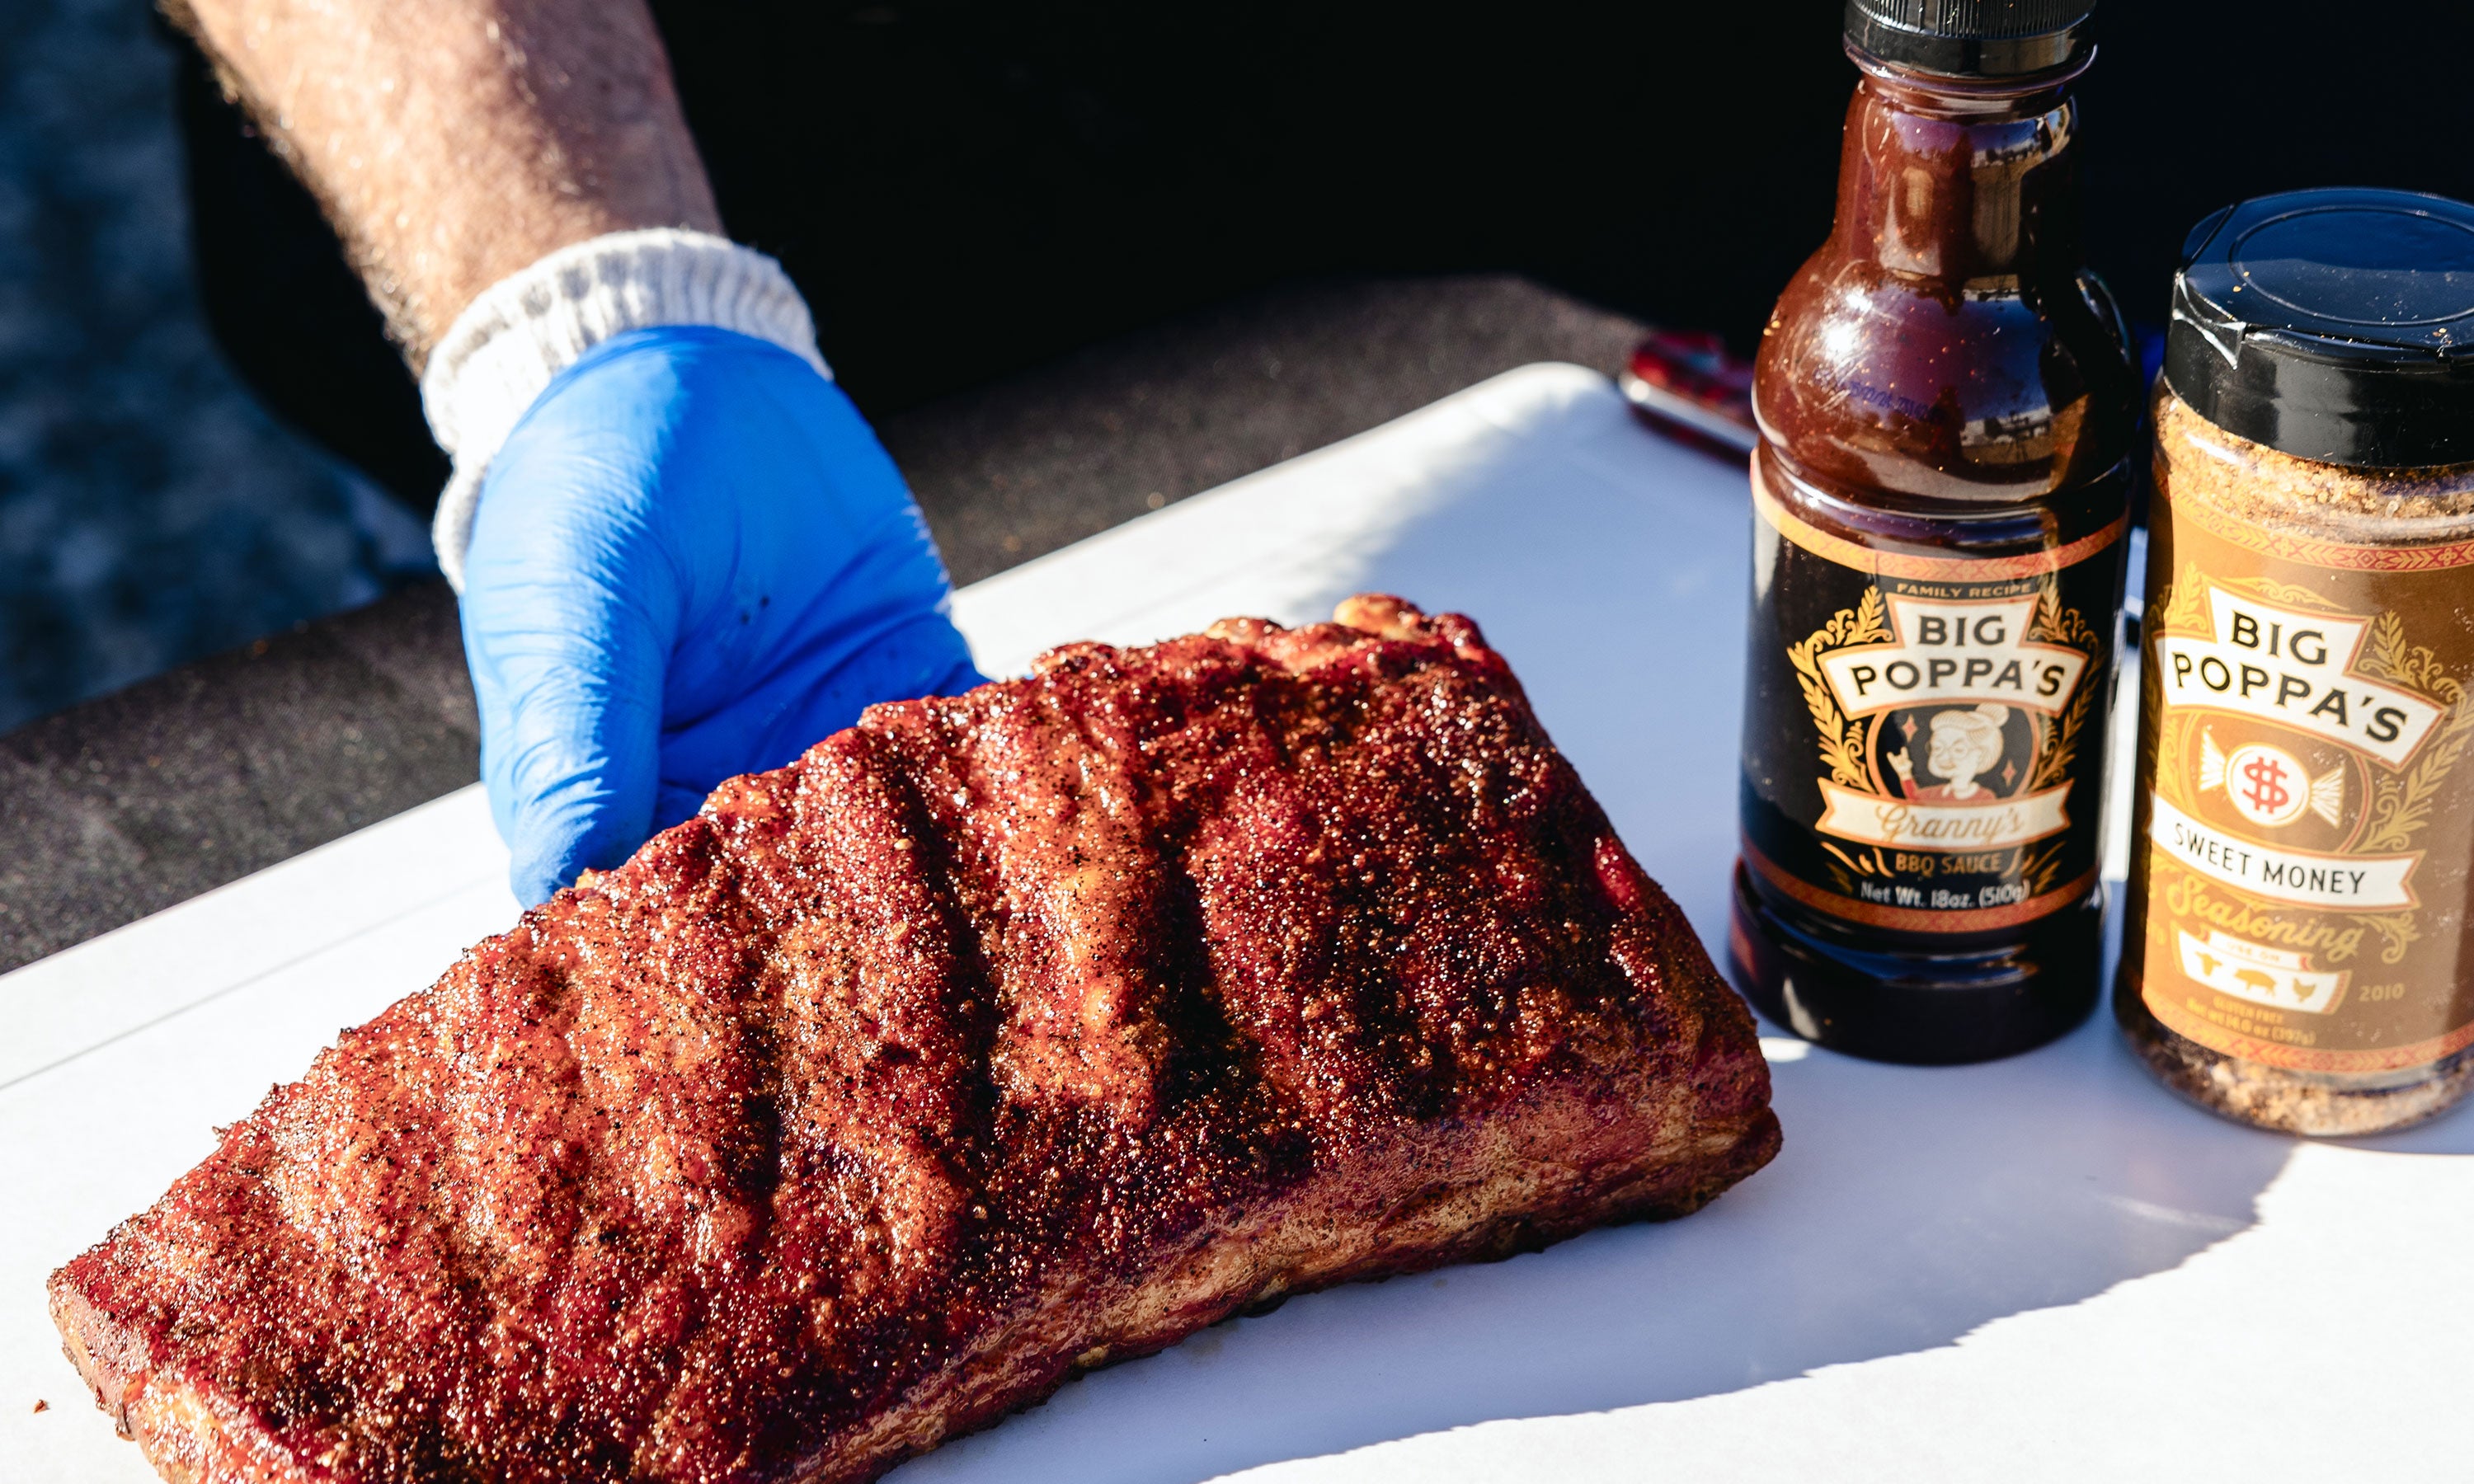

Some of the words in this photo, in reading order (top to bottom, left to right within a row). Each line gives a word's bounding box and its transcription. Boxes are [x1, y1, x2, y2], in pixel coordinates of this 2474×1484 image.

[1897, 583, 1961, 598] FAMILY
[1969, 583, 2031, 598] RECIPE
[1918, 615, 2006, 646] BIG
[2231, 609, 2328, 666] BIG
[1849, 659, 2065, 697] POPPA'S
[2171, 650, 2408, 743] POPPA'S
[1875, 805, 2023, 842] Granny's
[1894, 852, 1935, 876] BBQ
[1941, 852, 2002, 874] SAUCE
[2175, 823, 2251, 876] SWEET
[2263, 860, 2366, 895] MONEY
[1860, 881, 1891, 901] Net
[1894, 885, 1927, 908] Wt.
[1978, 878, 2030, 909] (510g)
[2166, 874, 2365, 963] Seasoning
[2359, 983, 2404, 1002] 2010
